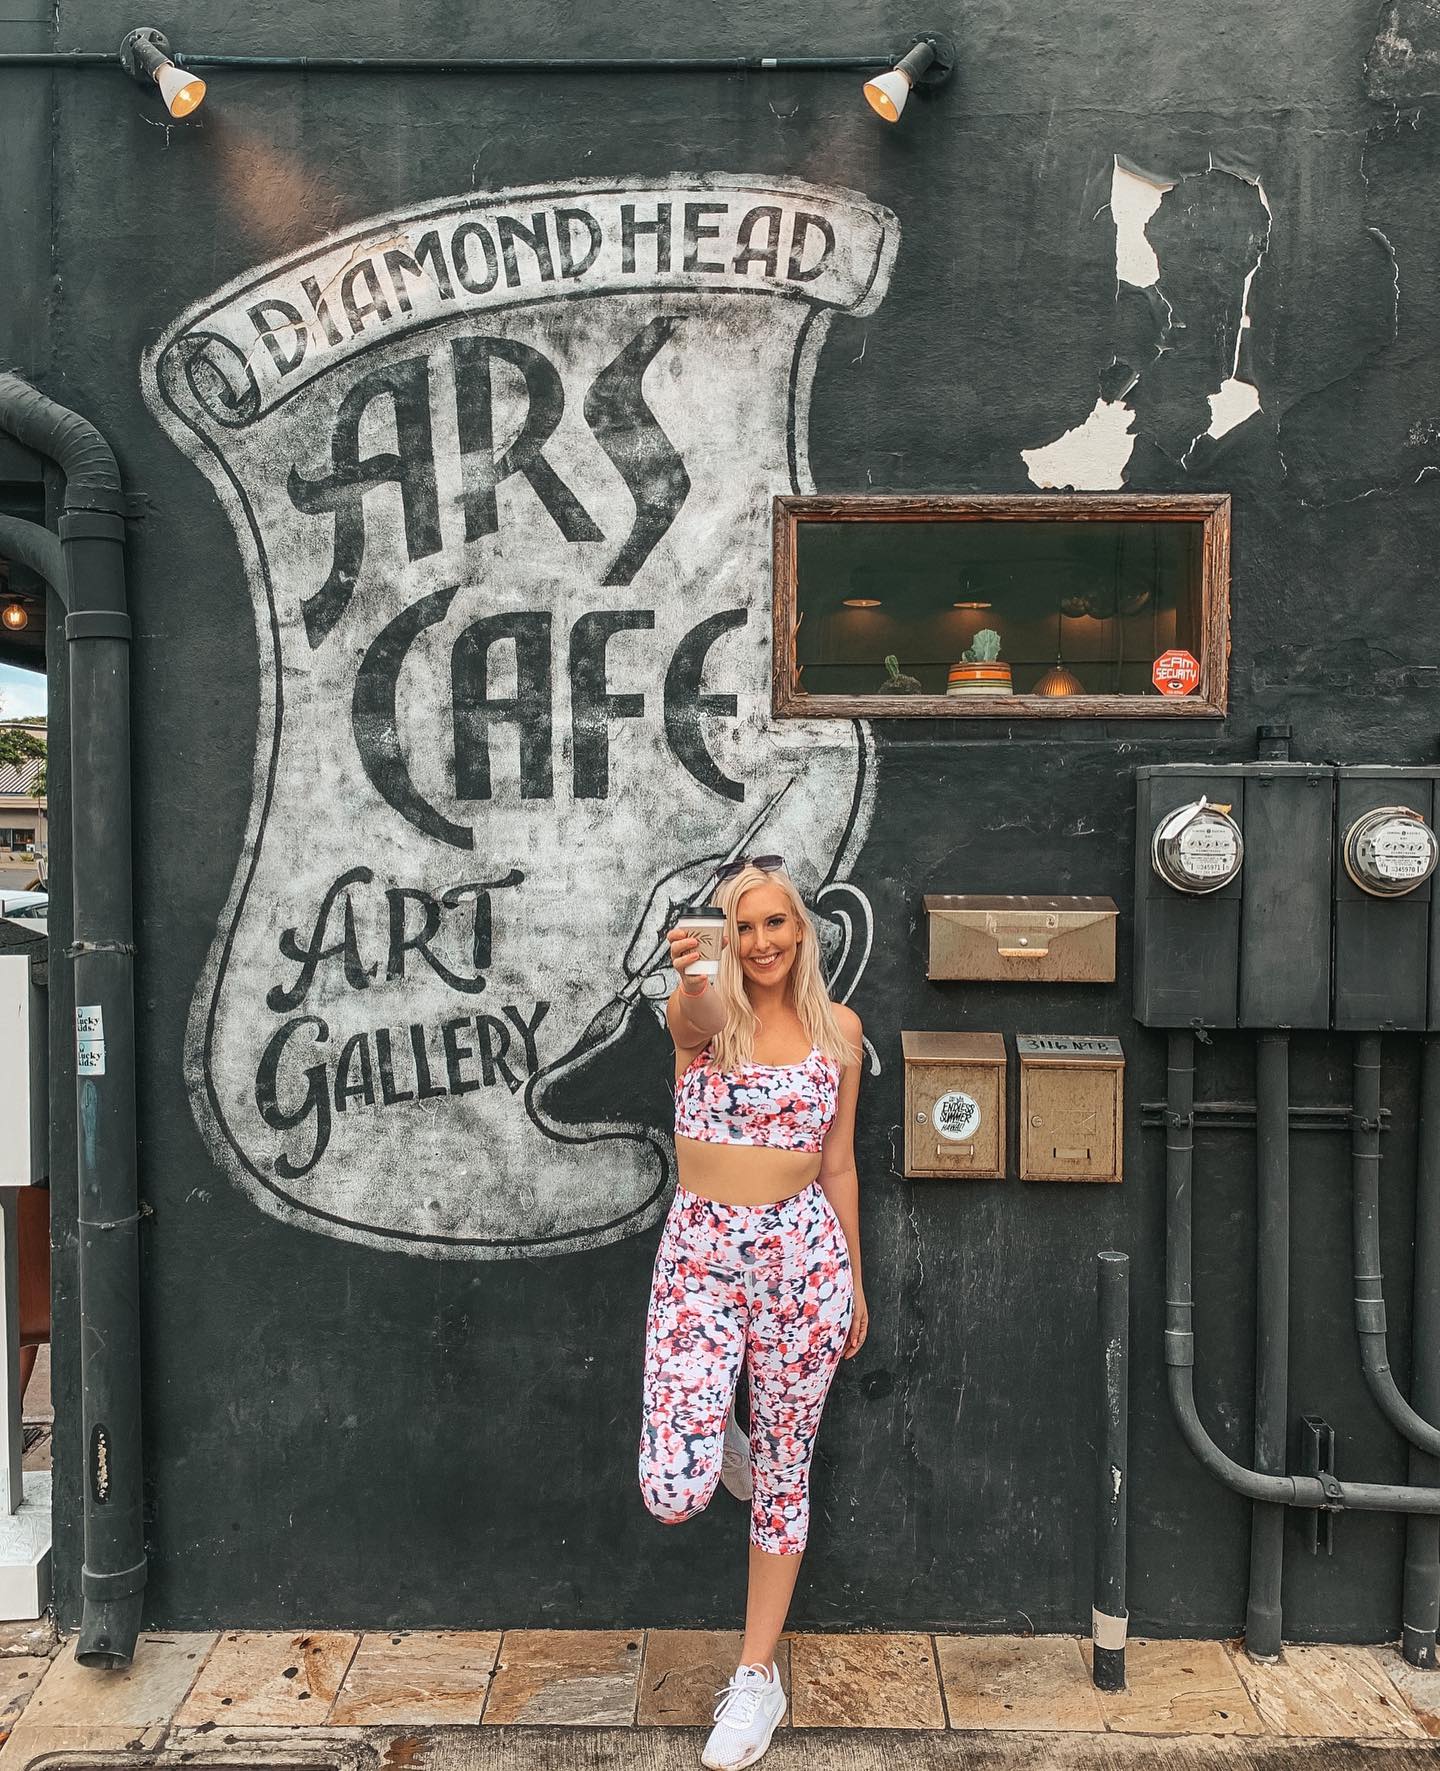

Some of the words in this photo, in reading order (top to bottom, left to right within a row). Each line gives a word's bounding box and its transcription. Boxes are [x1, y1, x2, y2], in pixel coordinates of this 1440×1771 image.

[246, 207, 601, 379] DIAMOND
[620, 202, 836, 282] HEAD
[287, 315, 691, 651] ARS
[352, 586, 748, 850] CAFE
[1155, 668, 1196, 682] SECURITY
[1160, 656, 1193, 669] CAM
[267, 866, 524, 1011] ART
[255, 1001, 550, 1178] GALLERY
[1026, 1039, 1067, 1050] 3116
